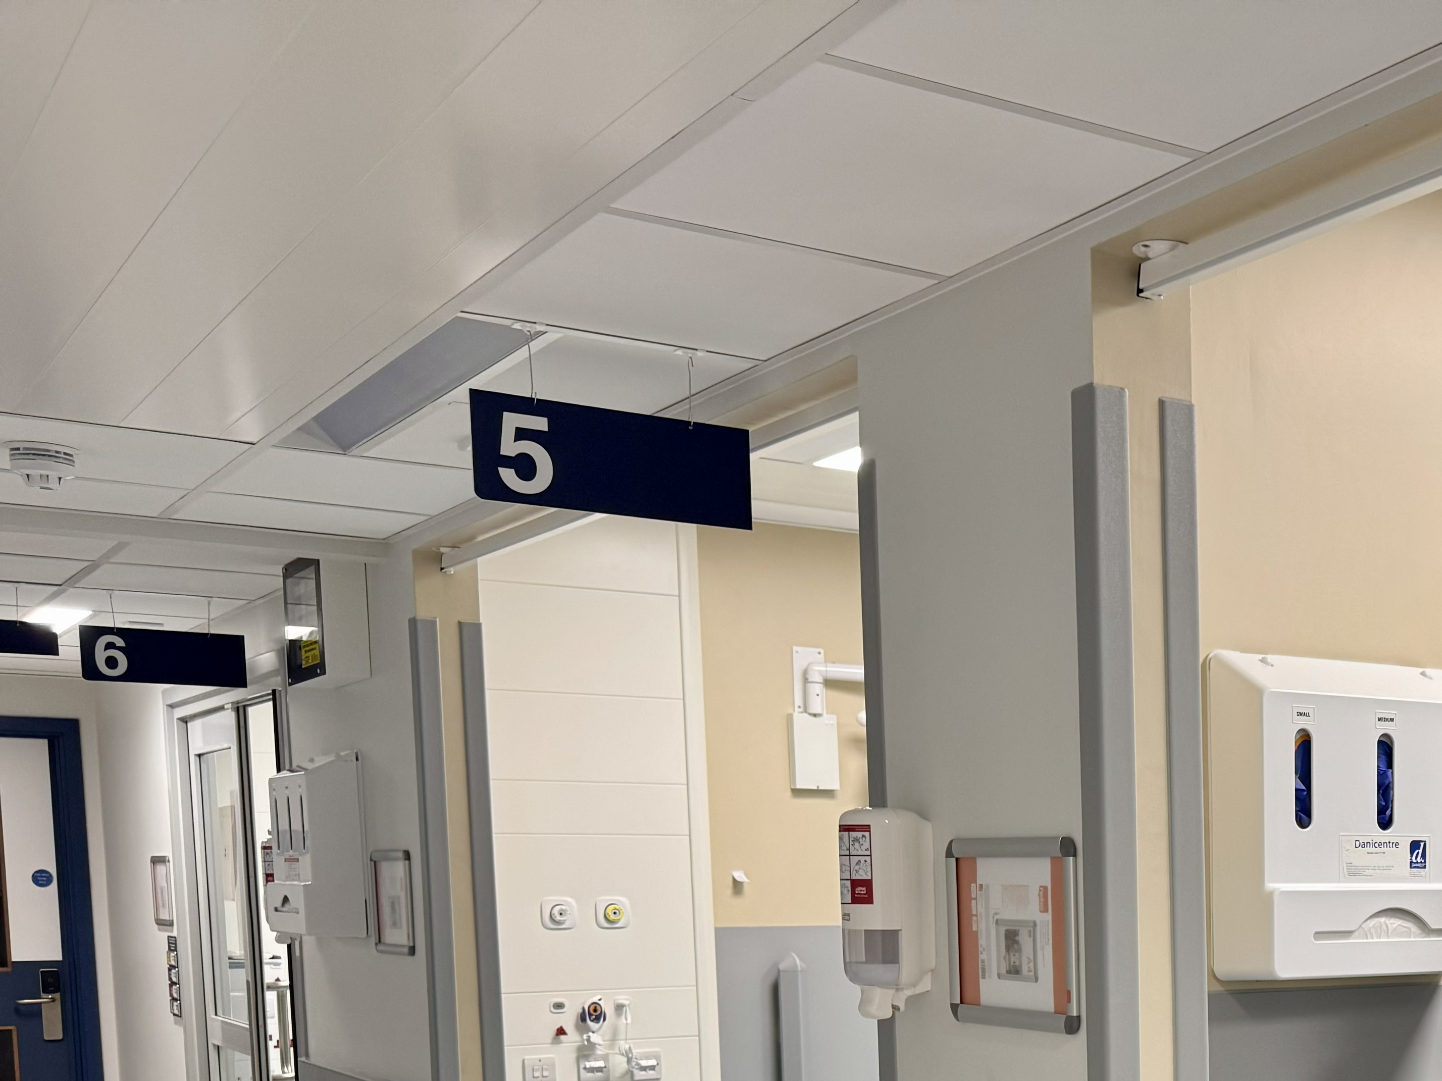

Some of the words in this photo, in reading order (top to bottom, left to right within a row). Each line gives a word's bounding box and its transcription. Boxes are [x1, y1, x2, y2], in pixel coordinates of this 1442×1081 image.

[497, 410, 555, 495] 5
[94, 634, 129, 677] 6
[1354, 839, 1400, 849] Danicentre
